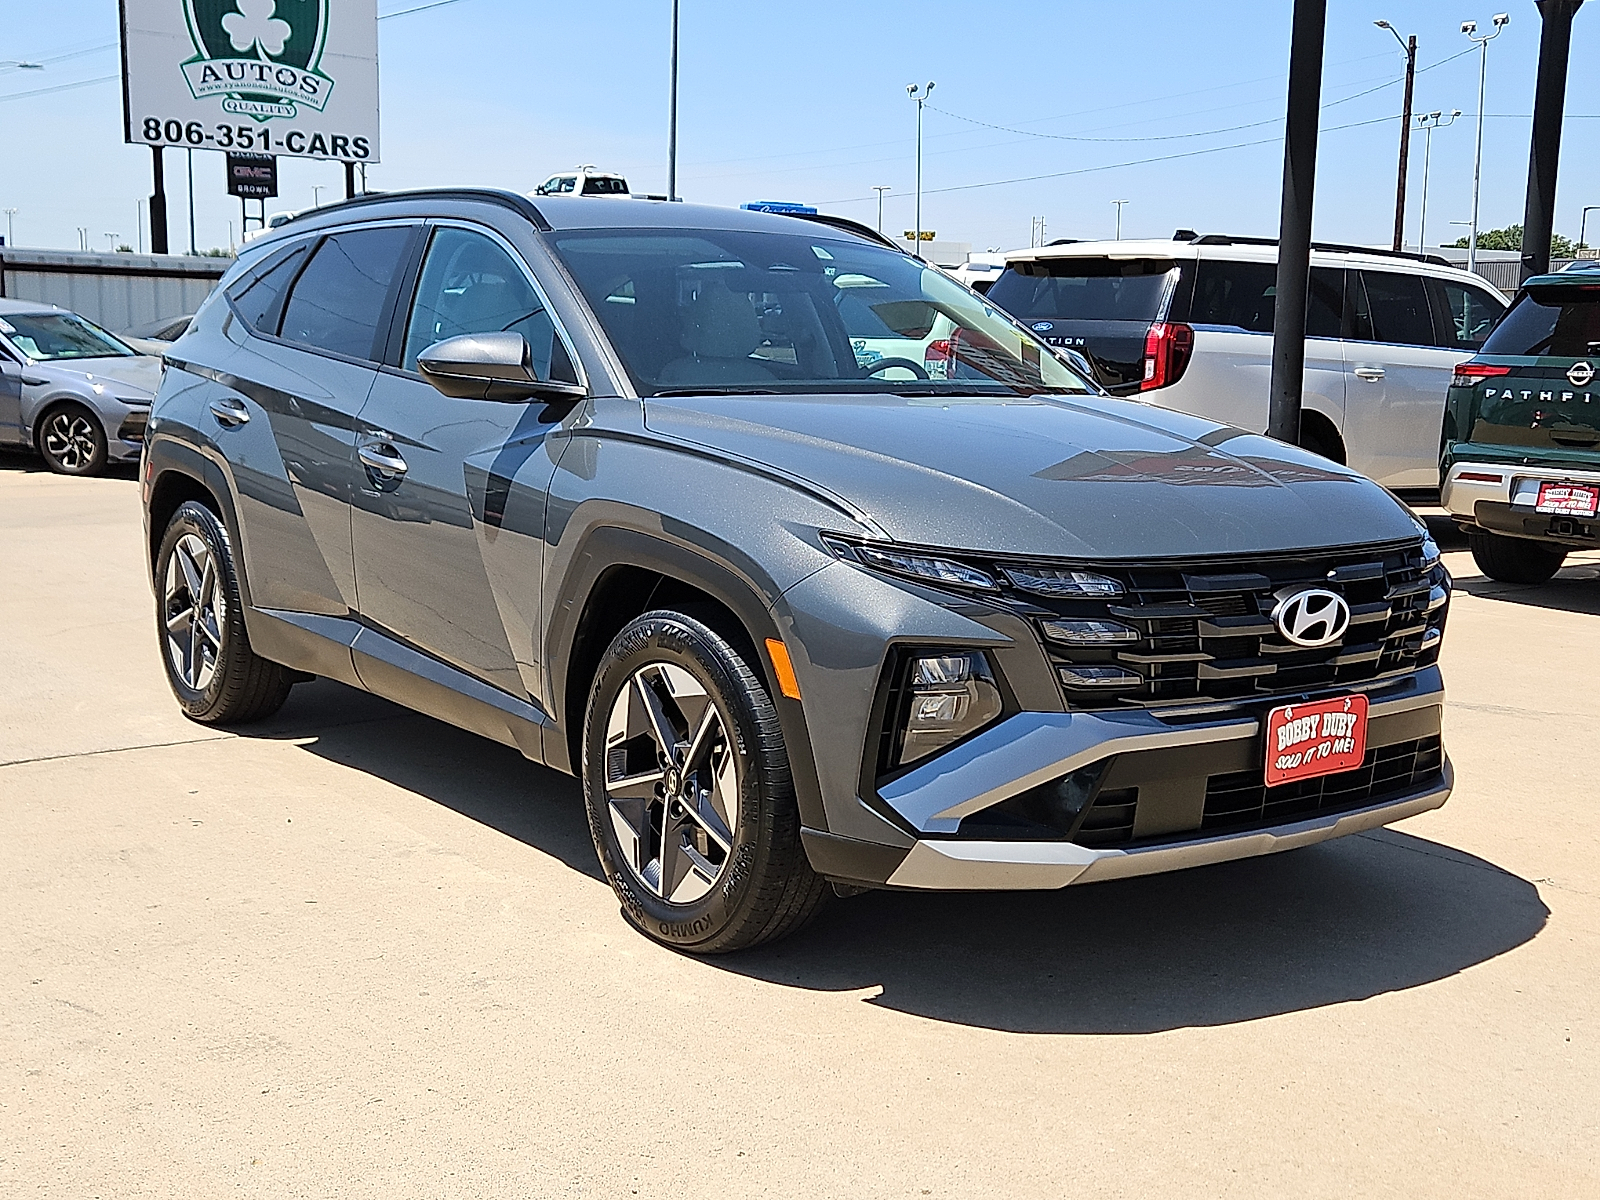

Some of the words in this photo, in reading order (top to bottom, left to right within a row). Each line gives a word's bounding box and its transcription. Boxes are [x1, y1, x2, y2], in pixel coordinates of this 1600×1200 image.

[200, 62, 321, 95] AUTOS
[198, 83, 319, 105] www.ryanonealautos.com
[227, 101, 293, 115] QUALITY
[143, 116, 370, 159] 806-351-CARS
[233, 165, 272, 178] GMC
[237, 184, 270, 195] BROWN
[1277, 714, 1320, 752] BOBBY
[1321, 712, 1358, 738] DUBY
[1275, 752, 1302, 770] SOLD
[1302, 747, 1317, 765] IT
[1316, 741, 1332, 760] TO
[1332, 737, 1355, 754] ME!
[658, 913, 714, 938] KUMHO
